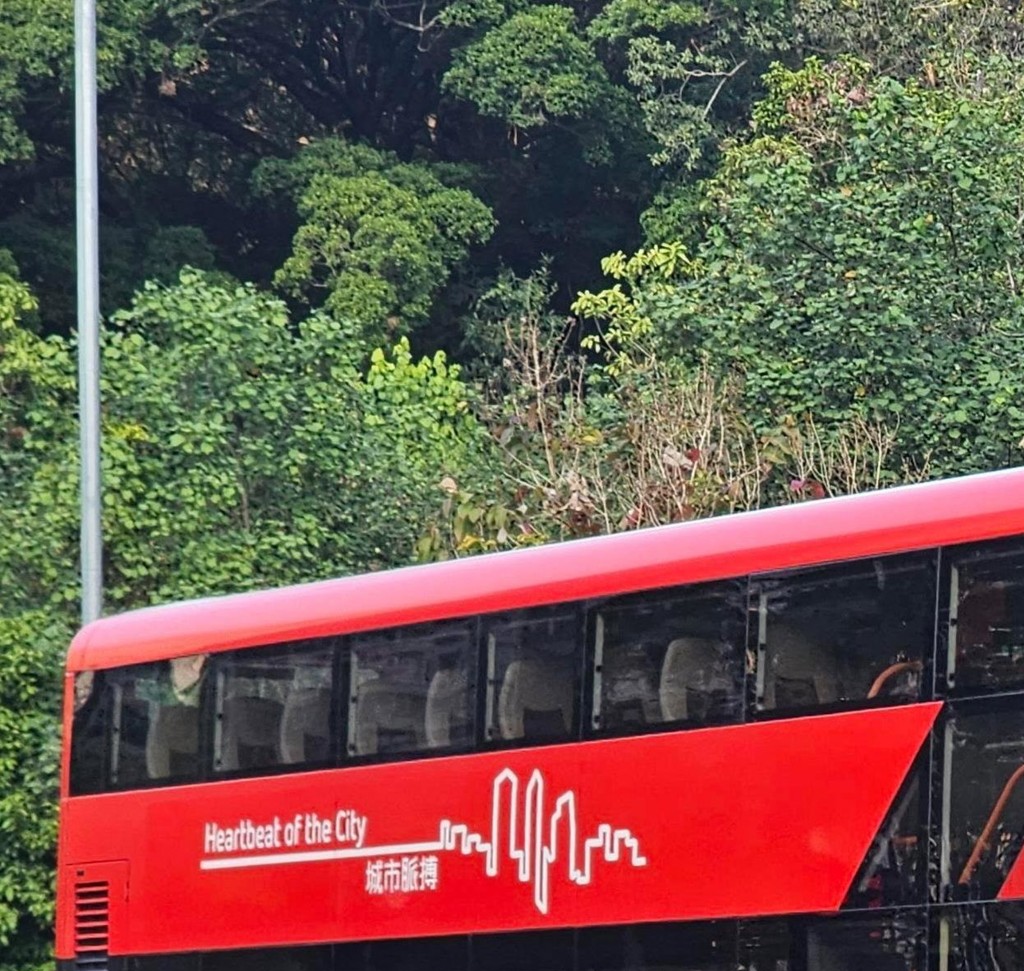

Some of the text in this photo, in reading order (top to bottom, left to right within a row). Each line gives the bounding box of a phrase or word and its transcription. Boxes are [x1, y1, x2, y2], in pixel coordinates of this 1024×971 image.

[204, 809, 367, 853] Heartbeat of the City
[365, 855, 438, 895] 城市脈搏
